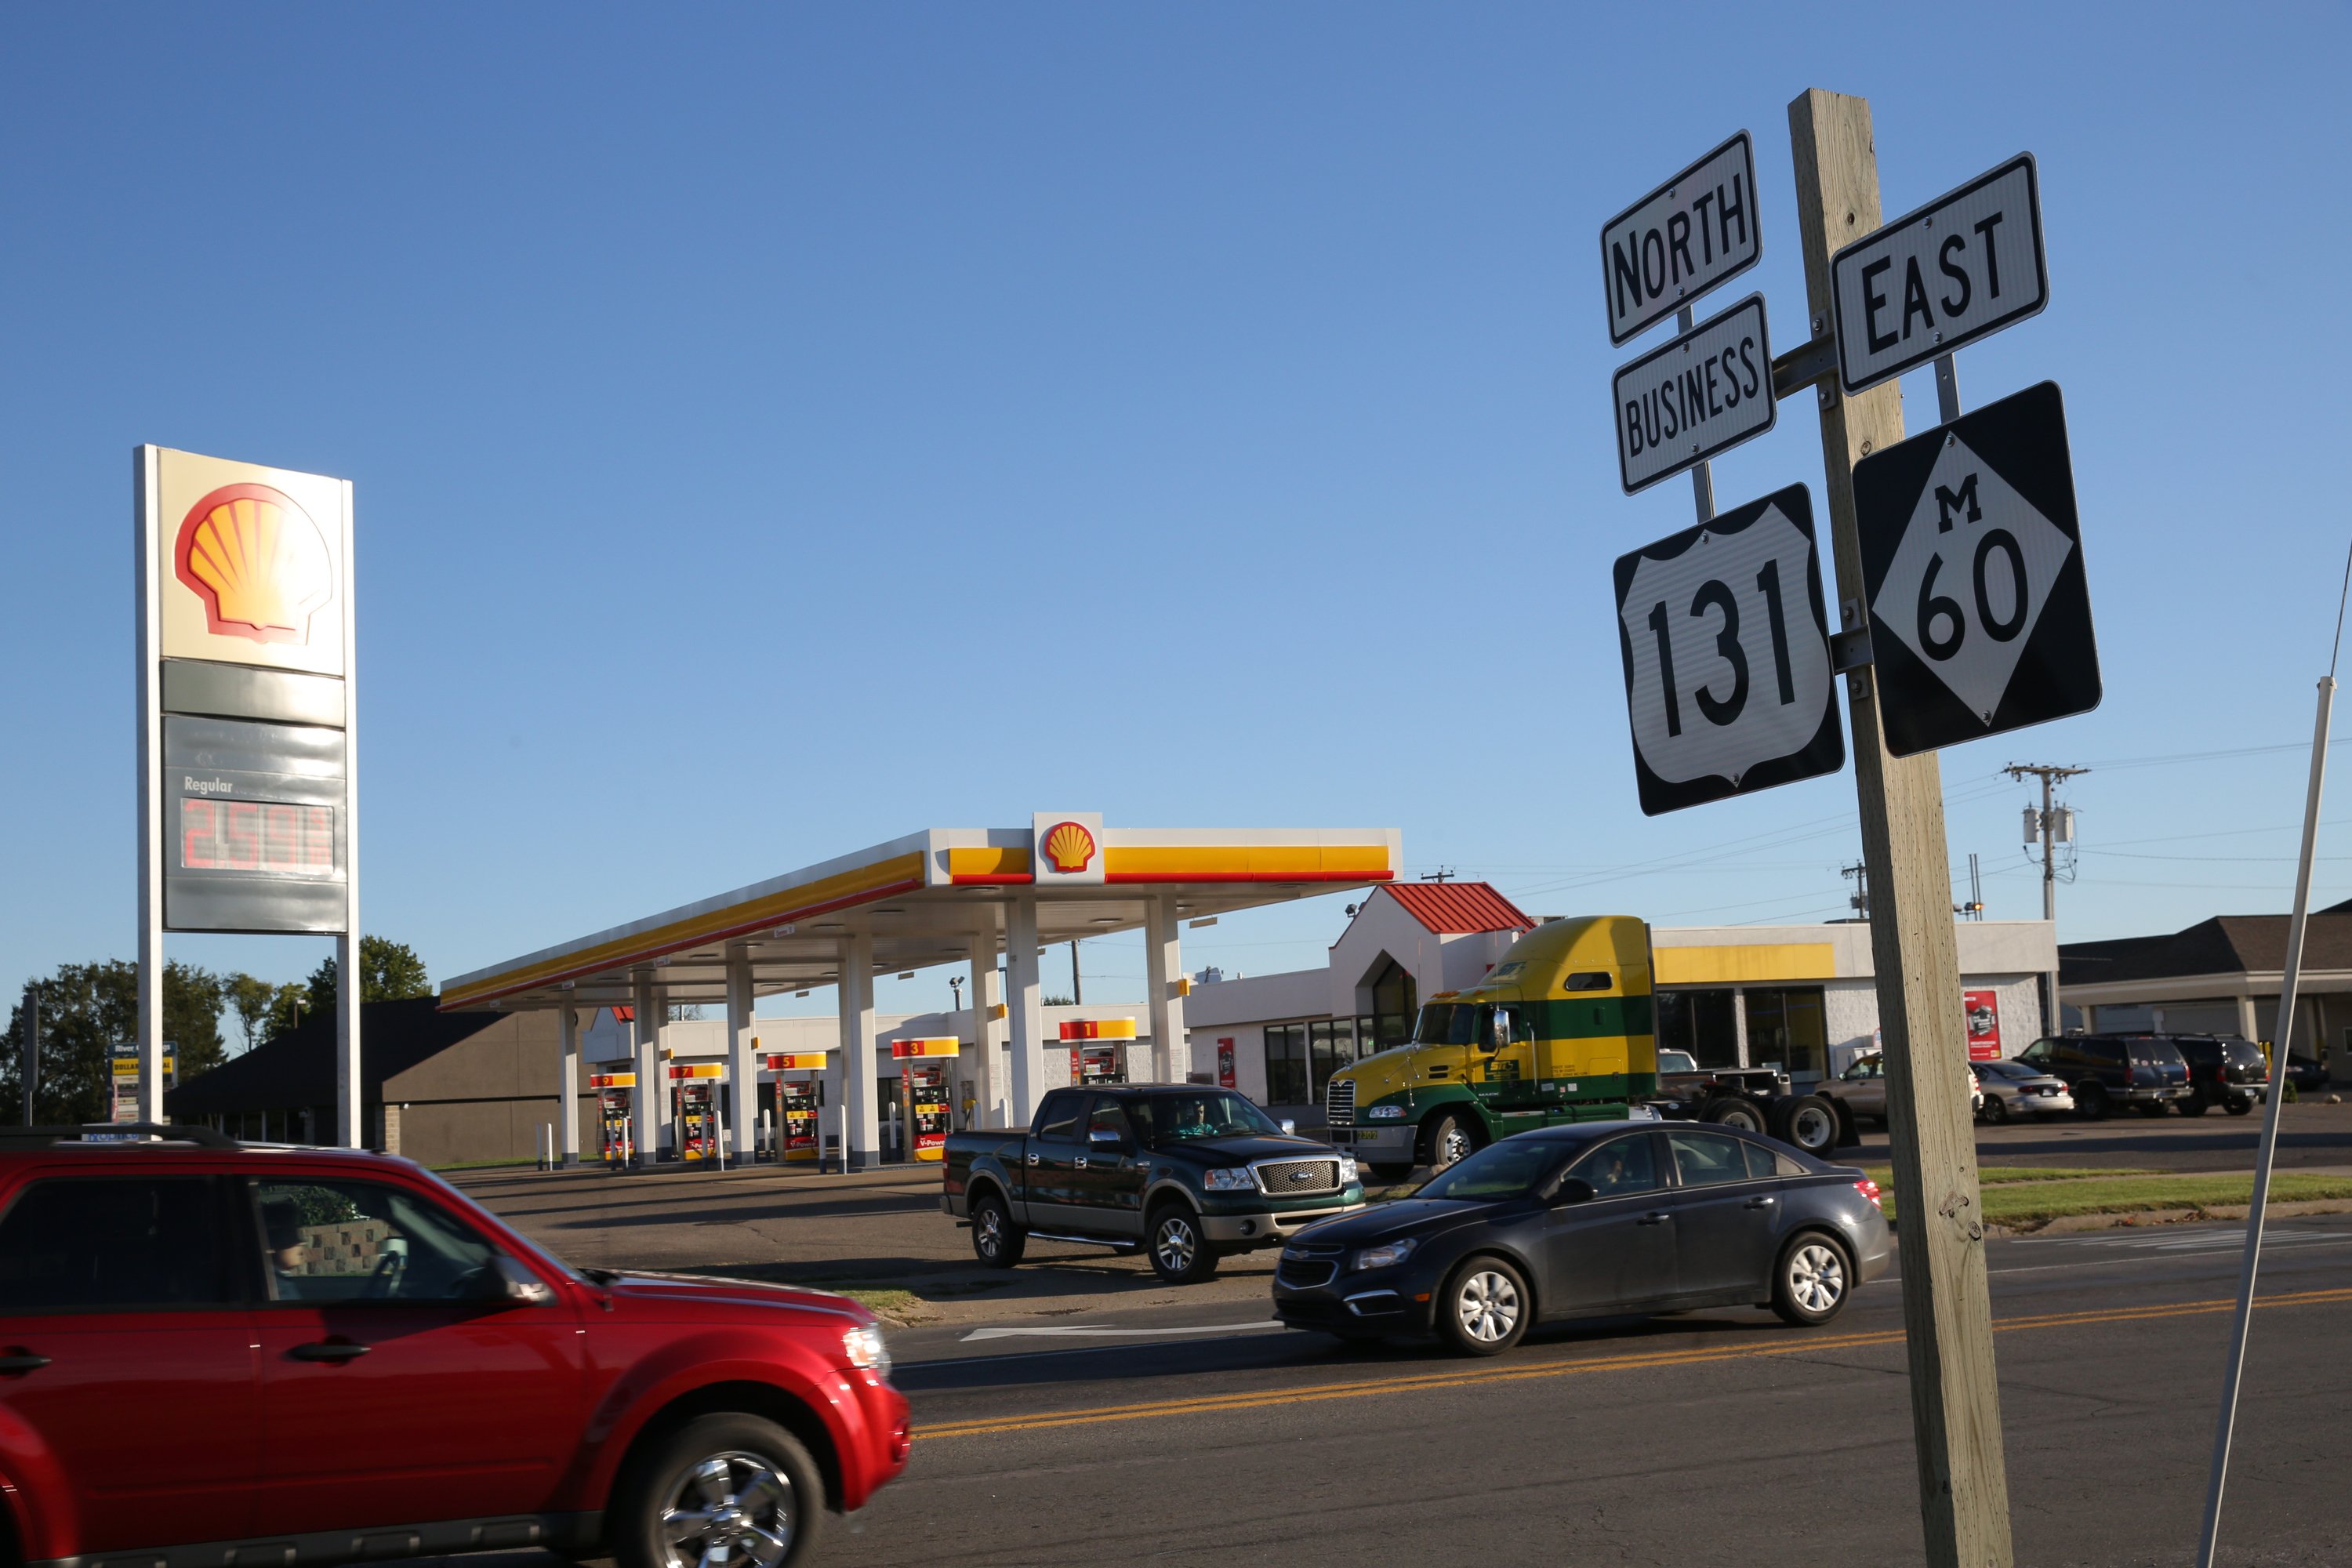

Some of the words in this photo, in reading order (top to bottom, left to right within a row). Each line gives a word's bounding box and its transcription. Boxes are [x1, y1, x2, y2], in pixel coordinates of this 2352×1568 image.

[1611, 173, 1747, 319] NORTH
[1860, 210, 2004, 356] EAST
[1624, 339, 1760, 458] BUSINESS
[1934, 472, 1983, 535] M
[1916, 528, 2029, 662] 60
[1647, 558, 1796, 738] 131
[184, 775, 233, 795] Regular
[909, 1042, 919, 1054] 3
[1084, 1023, 1091, 1036] 1
[681, 1068, 689, 1076] 7
[782, 1057, 790, 1066] 5
